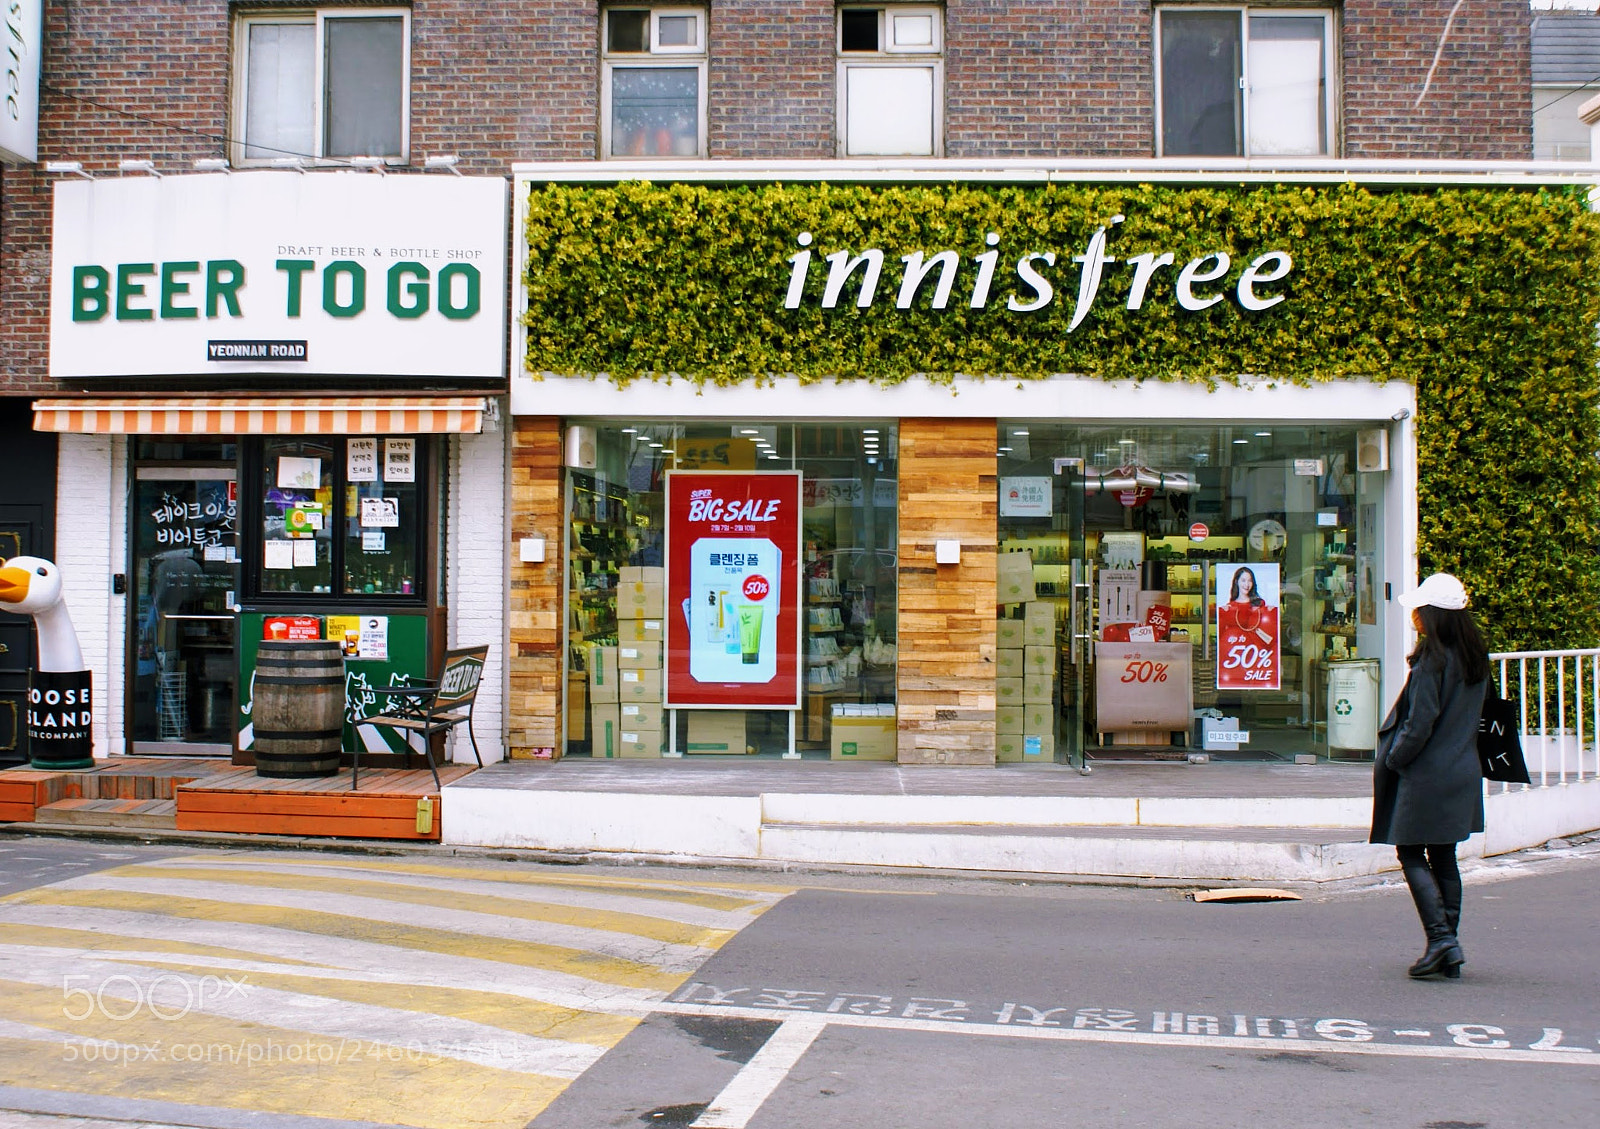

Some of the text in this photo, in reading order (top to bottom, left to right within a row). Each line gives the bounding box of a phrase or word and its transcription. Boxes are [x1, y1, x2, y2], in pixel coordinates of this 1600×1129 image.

[277, 245, 483, 259] DRAFT BEER & BOTTLE SHOP
[784, 214, 1293, 334] innisfree
[72, 259, 481, 323] BEER TO GO
[208, 344, 305, 357] YEONNAN ROAD
[690, 489, 712, 498] SUPER
[688, 499, 781, 522] BIG SALE
[156, 526, 223, 551] 비어투고
[709, 553, 759, 566] 클렌징 폼
[744, 581, 768, 595] 50%
[1149, 615, 1168, 626] 50%
[1227, 634, 1247, 644] up to
[1133, 651, 1142, 659] to
[1223, 644, 1272, 669] 50%
[440, 665, 465, 693] BEER
[1120, 660, 1169, 684] 50%
[1244, 669, 1272, 681] SALE
[39, 731, 88, 740] COMPANY
